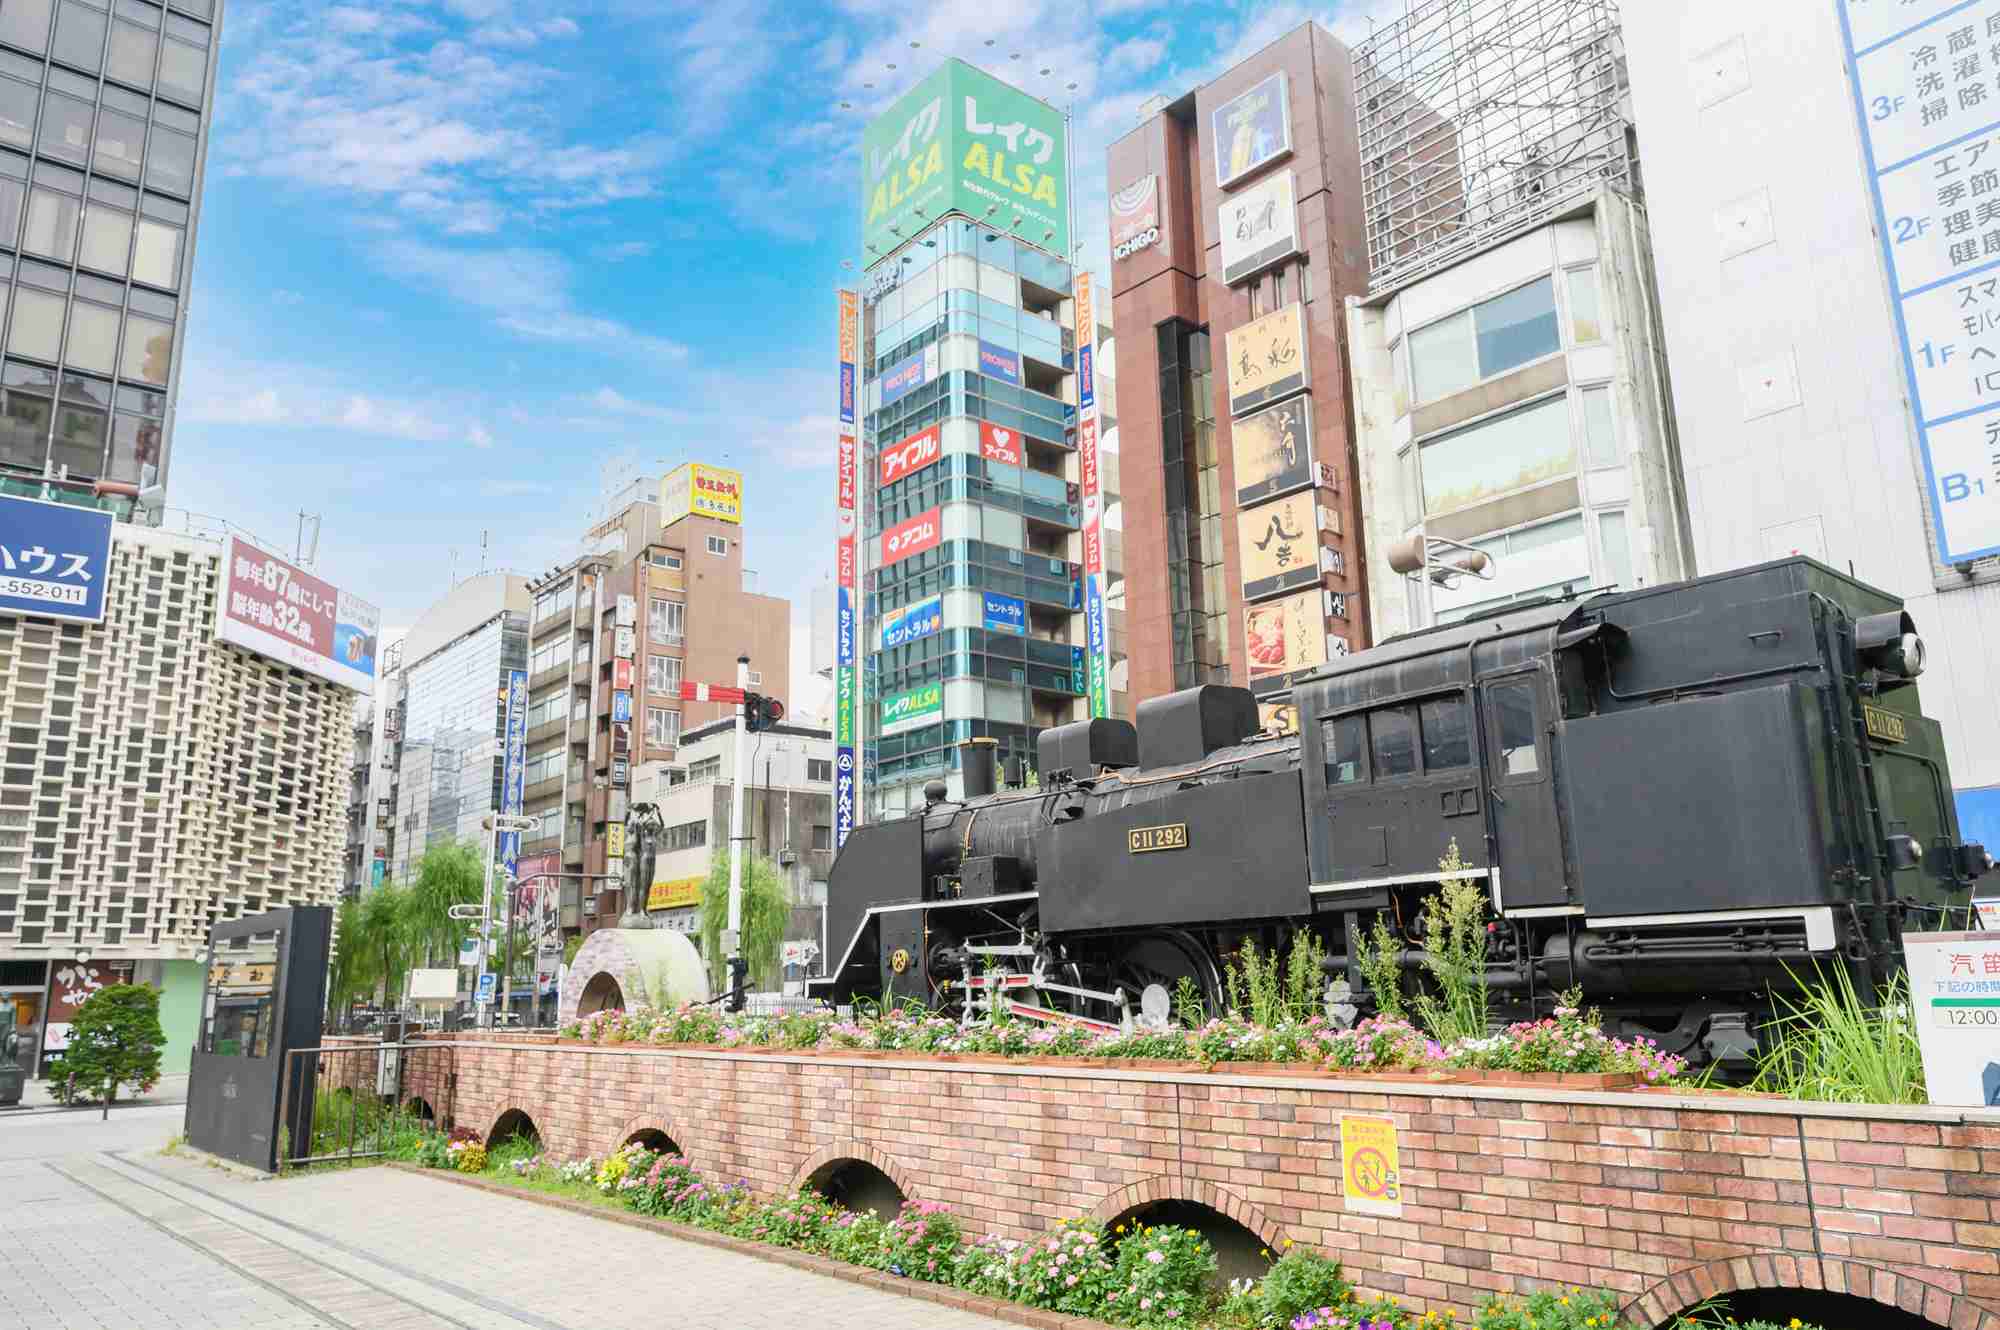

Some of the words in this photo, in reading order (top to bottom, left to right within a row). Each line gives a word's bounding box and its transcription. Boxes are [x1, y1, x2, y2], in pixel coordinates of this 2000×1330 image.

[1872, 95, 1904, 121] 3F
[1920, 77, 2000, 128] 掃除
[965, 95, 1054, 164] レイク
[1934, 137, 2000, 179] エア
[867, 140, 944, 225] ALSA
[963, 142, 1056, 208] ALSA
[1937, 168, 1999, 208] 季節
[1113, 227, 1159, 261] ICHIGO
[1893, 216, 1933, 244] 2F
[1963, 309, 2000, 337] モバ
[1918, 342, 1955, 368] 1F
[885, 432, 937, 478] アイフル
[984, 444, 1016, 464] アイフル
[1941, 473, 1985, 503] B1
[901, 522, 934, 549] アコム
[987, 601, 1022, 617] セントラル
[840, 609, 851, 657] セントラル
[887, 619, 931, 646] セントラル
[1951, 953, 2000, 975] 汽笛
[1948, 1010, 1998, 1026] 12:00
